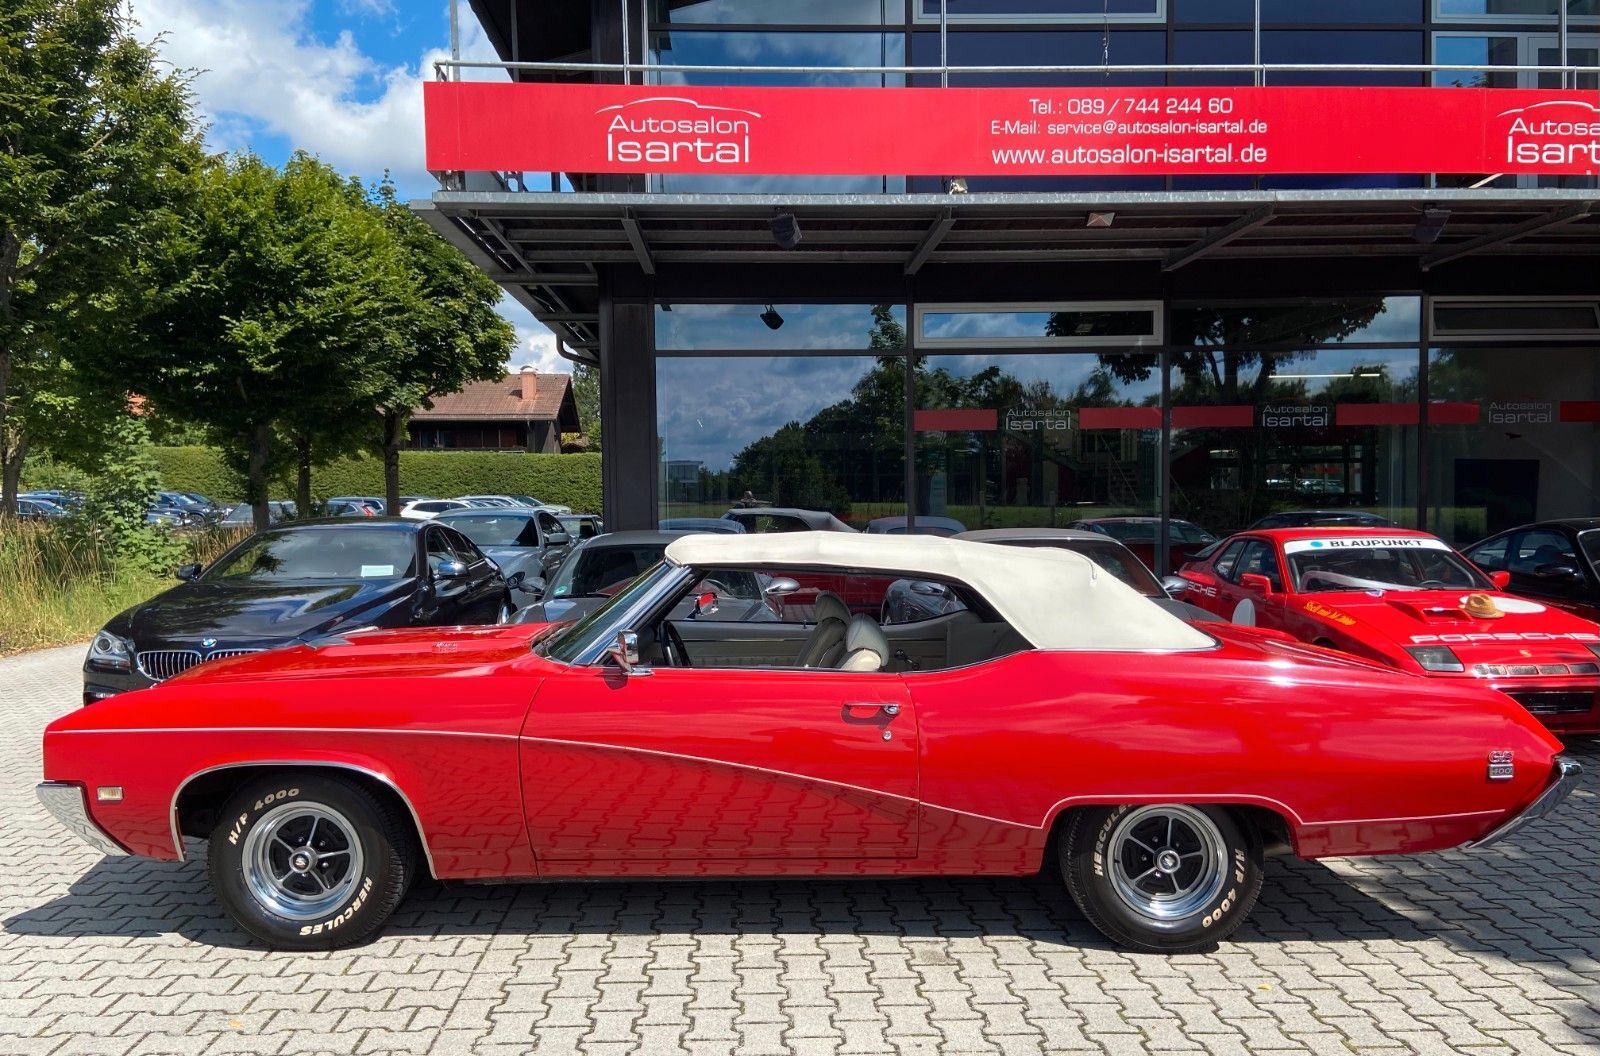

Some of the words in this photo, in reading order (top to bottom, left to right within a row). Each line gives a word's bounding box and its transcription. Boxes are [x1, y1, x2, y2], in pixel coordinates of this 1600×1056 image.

[1029, 99, 1062, 115] Tel.:
[1067, 99, 1104, 115] 089
[1124, 98, 1159, 114] 744
[1166, 98, 1202, 114] 244
[1208, 98, 1233, 113] 60
[608, 115, 749, 134] Autosalon
[991, 120, 1040, 135] E-Mail:
[1047, 119, 1267, 135] service@autosalon-isartal.de
[607, 133, 749, 163] Isartal
[992, 143, 1267, 164] www.autosalon-isartal.de
[1006, 408, 1071, 418] Autosalon
[1262, 404, 1329, 414] Autosalon
[1489, 401, 1552, 411] Autosalon
[1005, 417, 1071, 431] Isartal
[1262, 412, 1329, 427] Isartal
[1488, 411, 1552, 424] Isartal
[1330, 540, 1423, 548] BLAUPUNKT
[1410, 632, 1600, 644] PORSCHE
[228, 811, 249, 846] H/P
[253, 787, 300, 812] 4000
[1093, 804, 1132, 877] HERCULE
[1234, 848, 1246, 884] H/P
[299, 876, 373, 936] HERCULES
[1202, 888, 1237, 928] 4000
